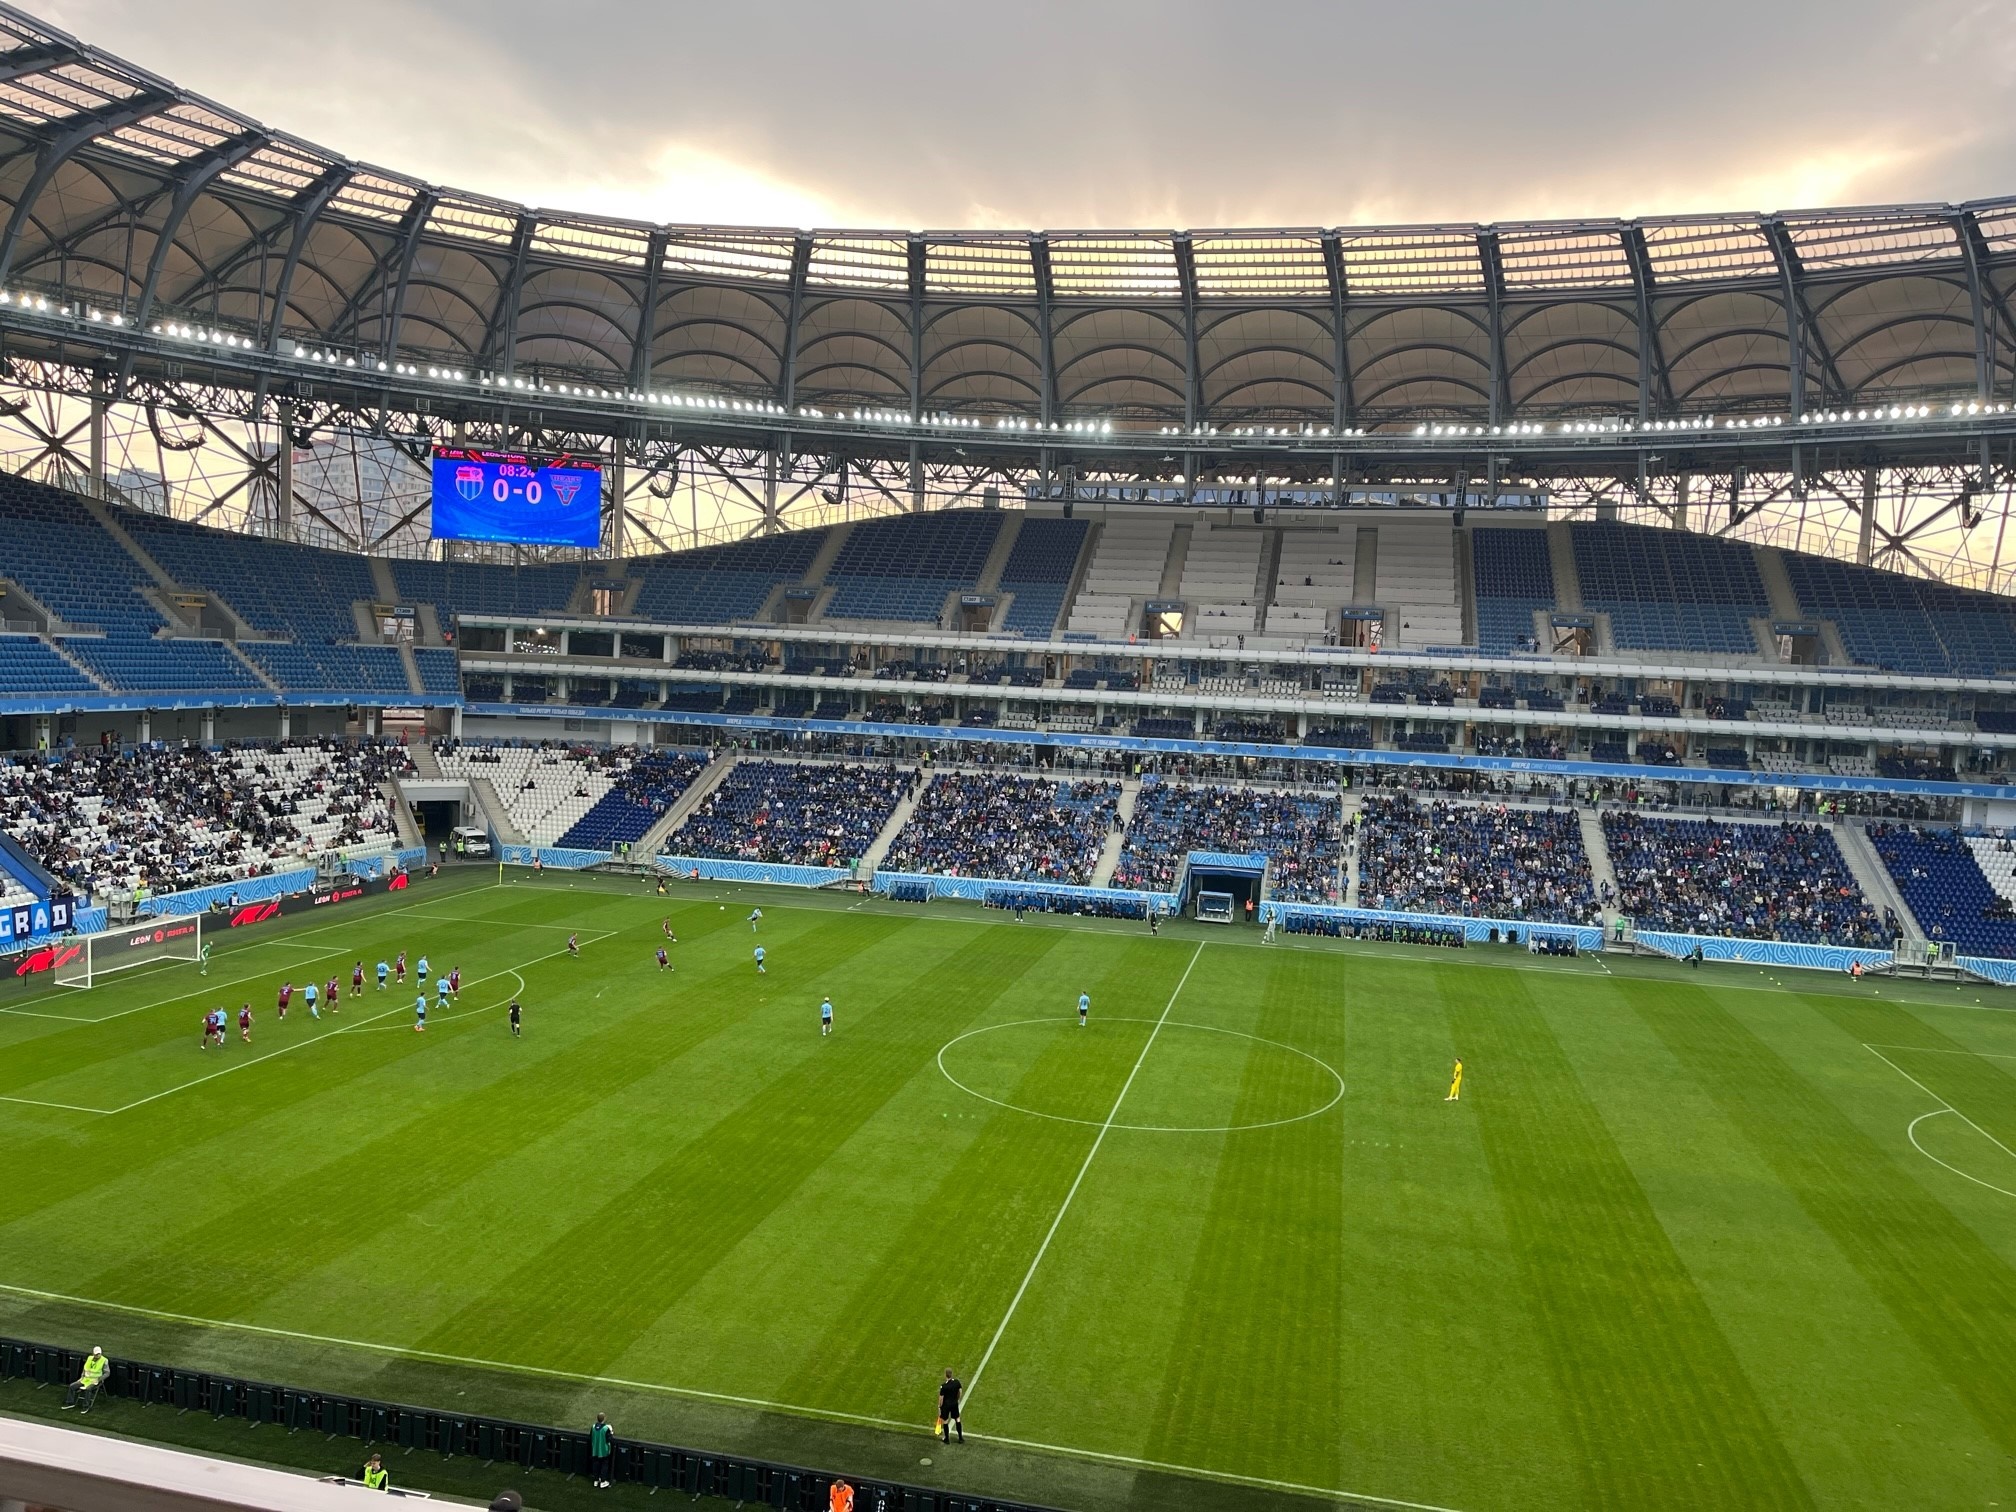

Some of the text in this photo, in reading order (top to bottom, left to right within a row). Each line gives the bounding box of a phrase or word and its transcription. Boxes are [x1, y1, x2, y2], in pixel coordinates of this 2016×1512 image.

[499, 464, 536, 478] 08:24
[492, 478, 542, 504] 0-0
[314, 895, 331, 905] LEON
[0, 904, 67, 938] GRAD
[130, 934, 151, 946] LEON
